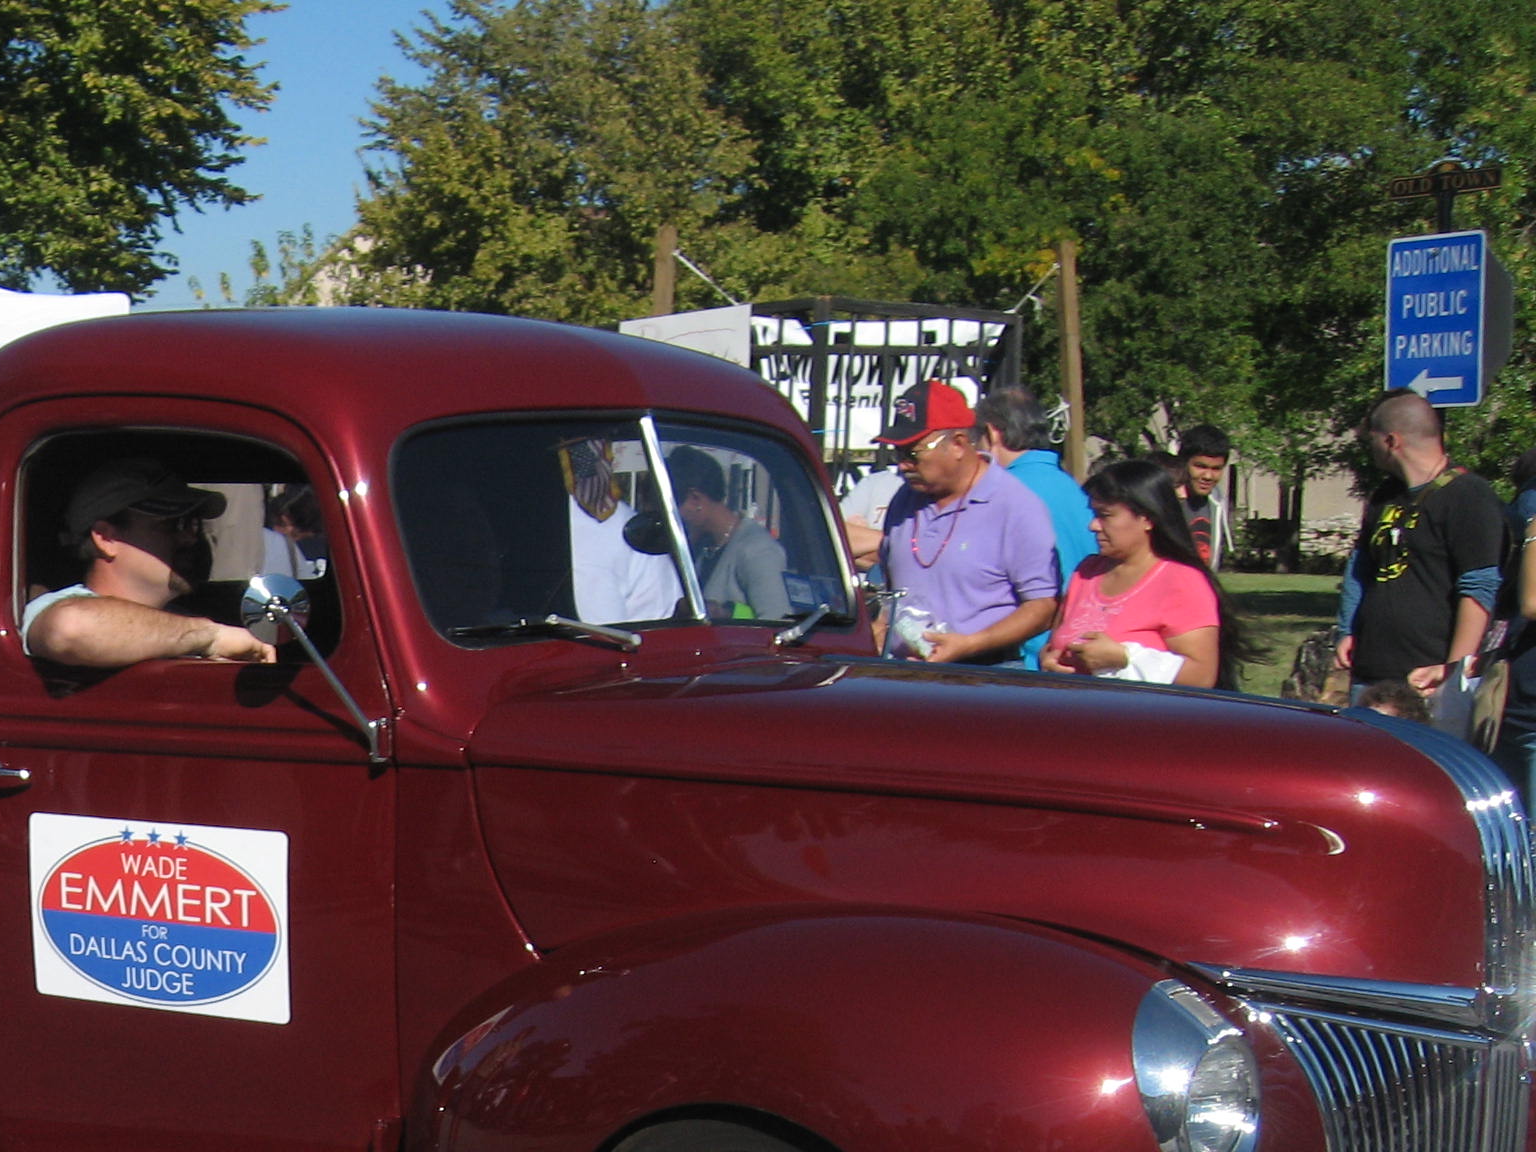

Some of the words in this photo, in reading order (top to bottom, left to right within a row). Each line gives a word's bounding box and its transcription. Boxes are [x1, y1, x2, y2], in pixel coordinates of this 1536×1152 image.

[1394, 178, 1432, 195] OLD
[1440, 171, 1497, 190] TOWN
[1392, 245, 1478, 277] ADDITIONAL
[1402, 289, 1468, 319] PUBLIC
[1394, 330, 1473, 360] PARKING
[120, 853, 187, 880] WADE
[60, 872, 256, 927] EMMERT
[141, 925, 167, 939] FOR
[70, 933, 147, 963] DALLAS
[154, 943, 246, 974] COUNTY
[121, 966, 194, 995] JUDGE
